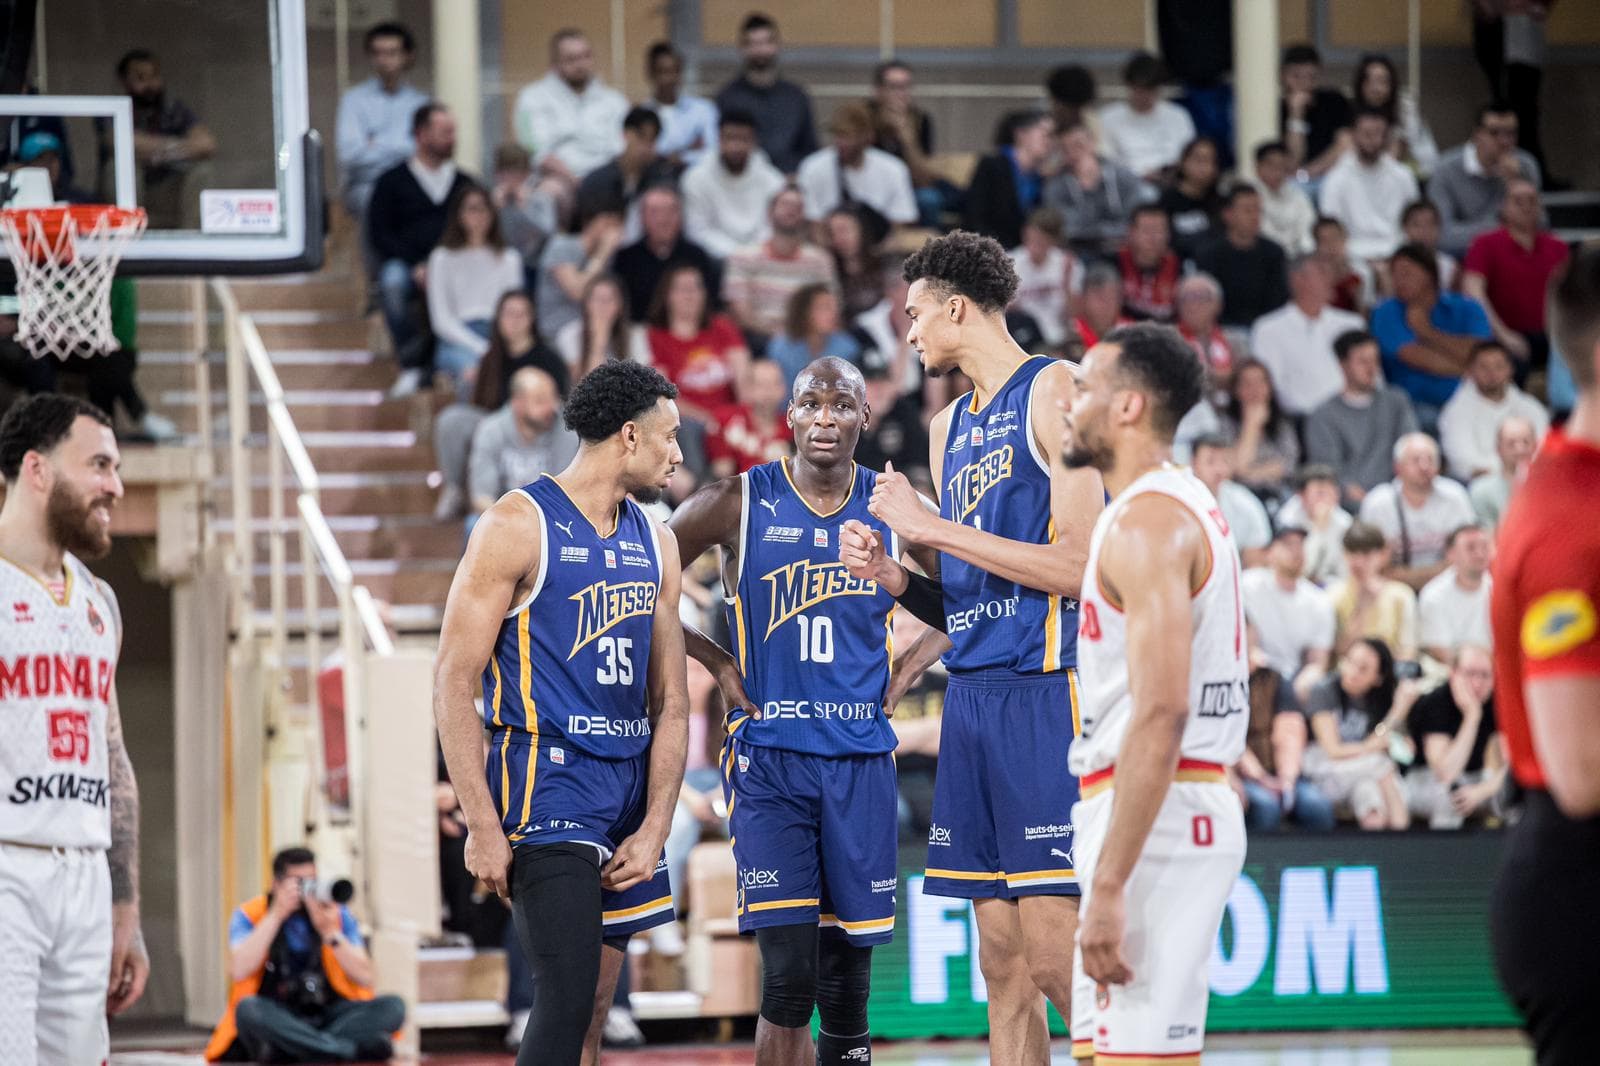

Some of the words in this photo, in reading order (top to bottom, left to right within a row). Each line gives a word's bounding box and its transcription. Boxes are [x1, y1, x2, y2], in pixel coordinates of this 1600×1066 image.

[946, 609, 975, 634] DEC
[973, 595, 1019, 621] POR
[797, 615, 834, 663] 10
[597, 637, 634, 685] 35
[764, 700, 810, 720] IDEC
[814, 702, 875, 720] SPORT
[613, 717, 651, 736] SPOR
[928, 822, 951, 842] dex
[1024, 822, 1075, 835] hauts-de-sein
[1192, 815, 1214, 846] 0
[743, 867, 779, 885] idex
